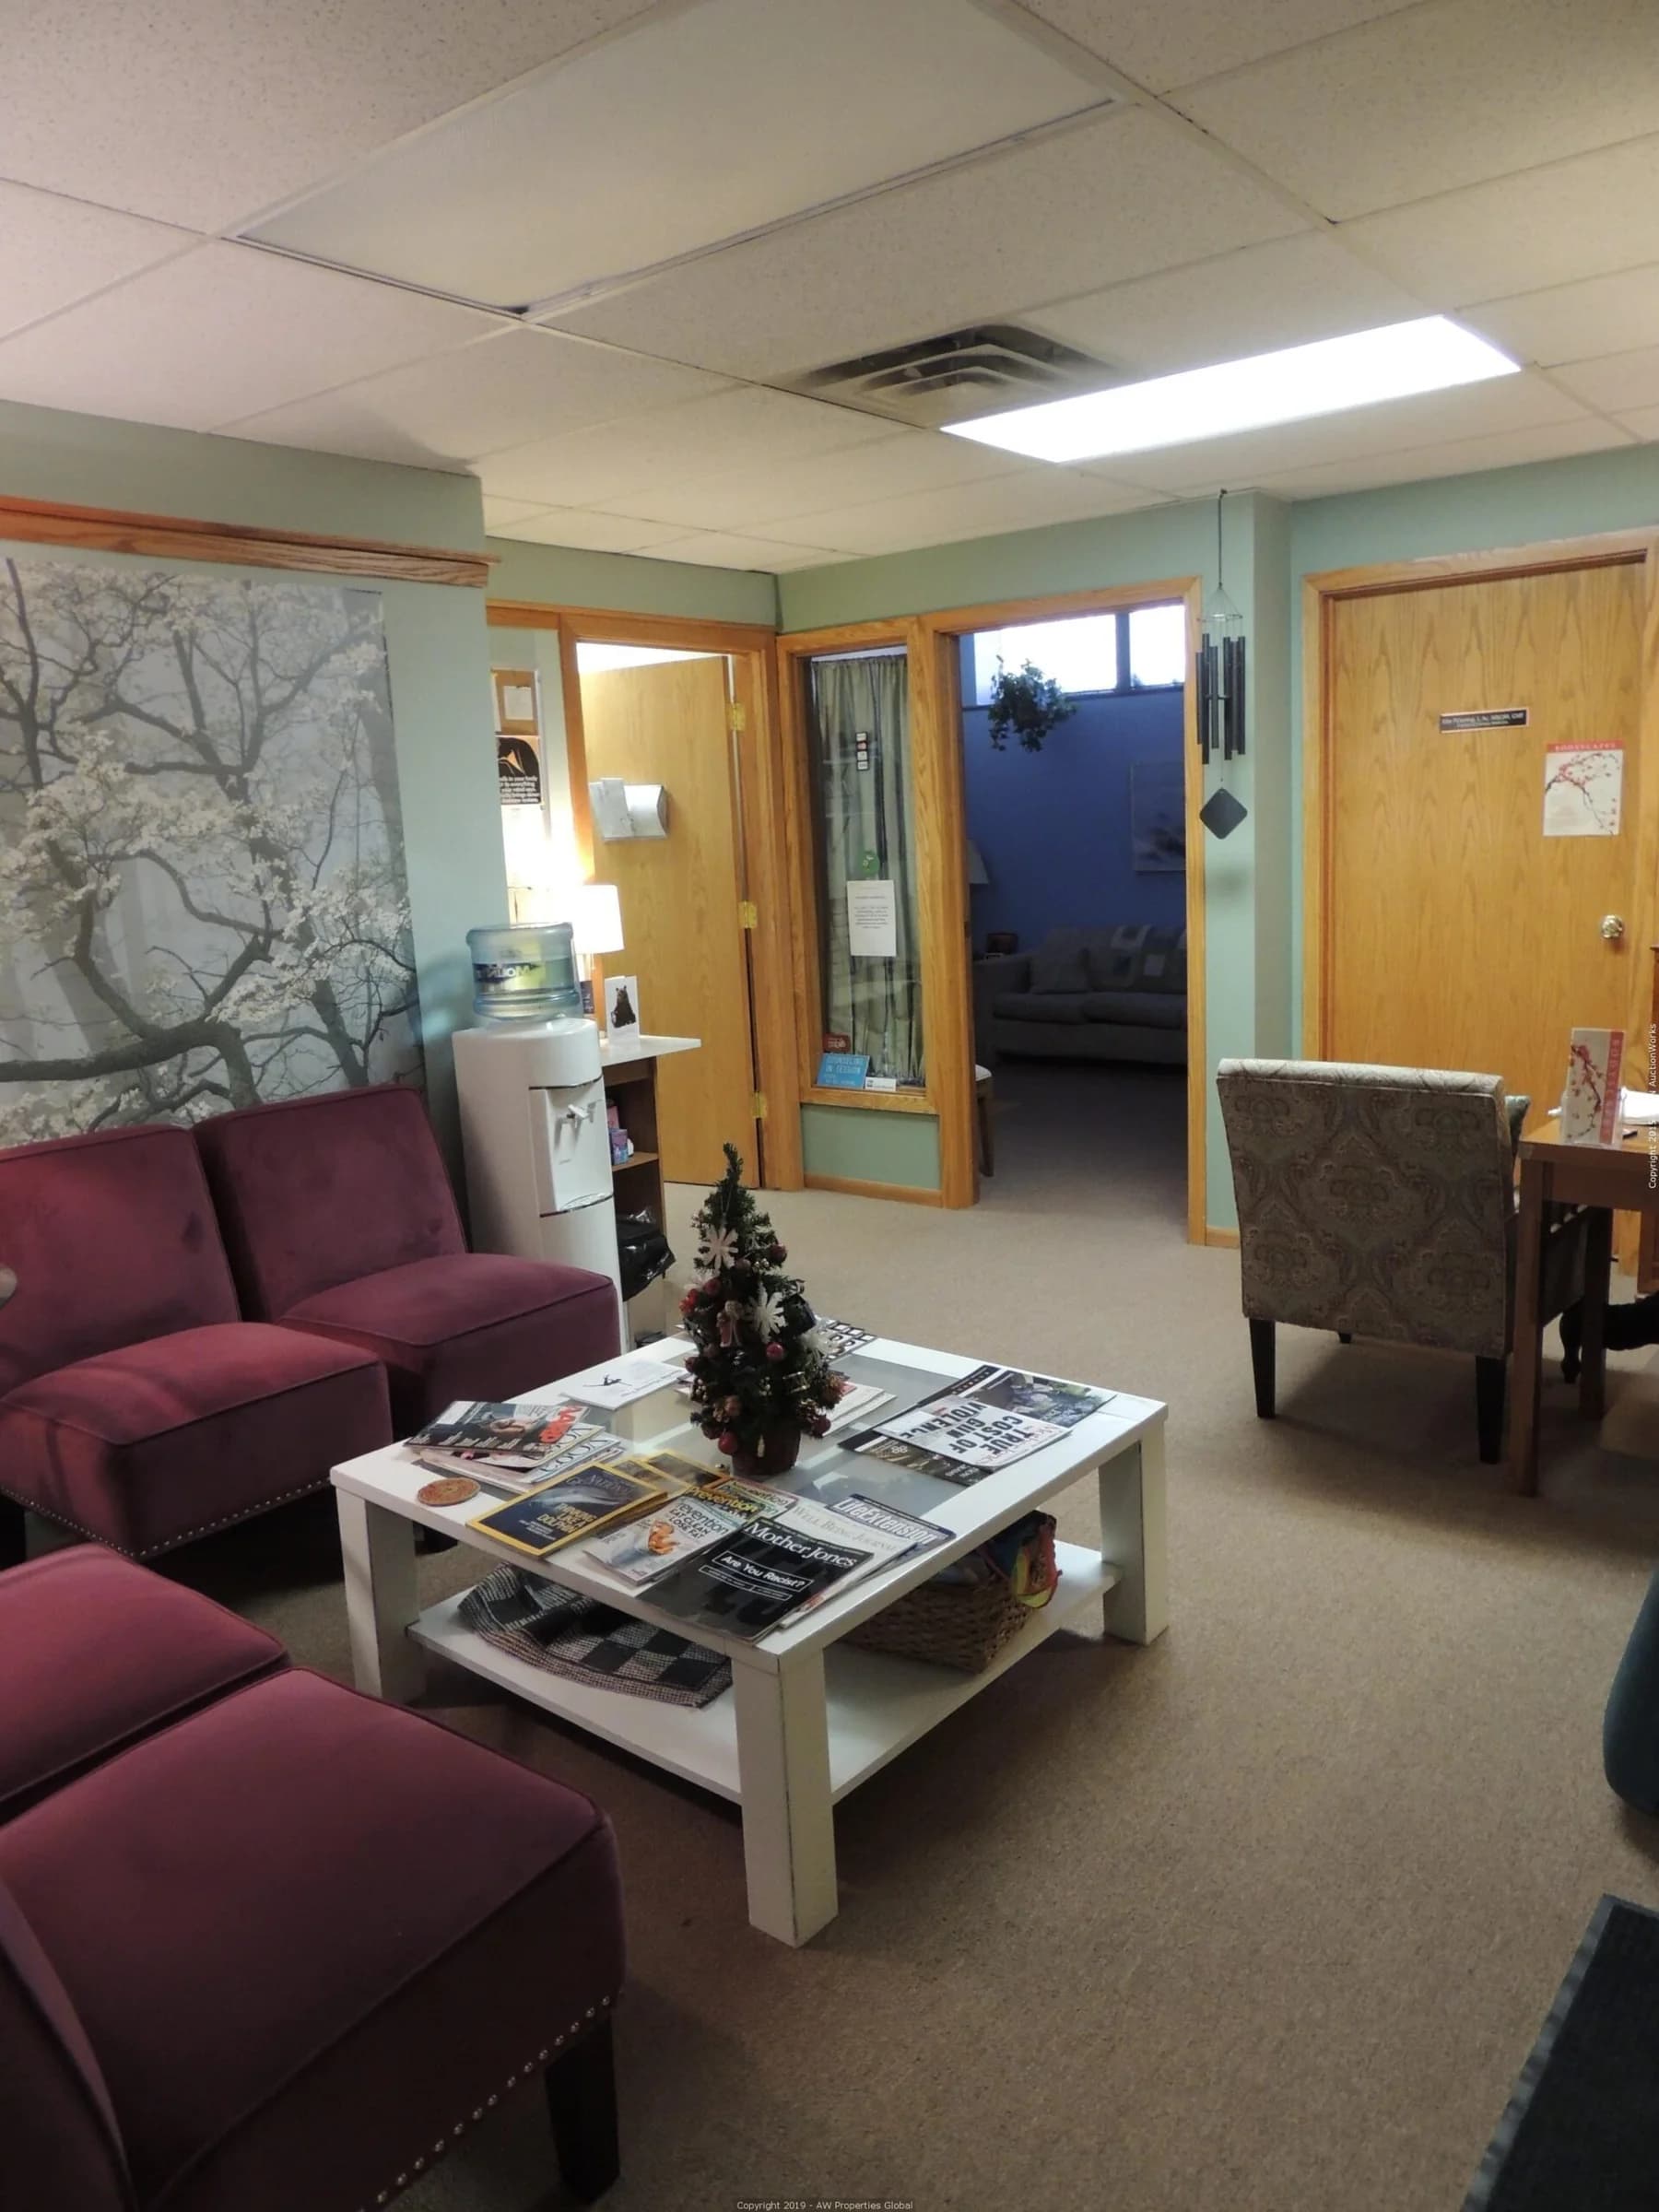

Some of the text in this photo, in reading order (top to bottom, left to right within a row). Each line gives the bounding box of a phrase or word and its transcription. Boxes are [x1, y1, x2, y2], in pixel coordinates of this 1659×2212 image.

[946, 1419, 986, 1439] GUN
[973, 1416, 1024, 1441] COST
[948, 1439, 978, 1453] OF
[981, 1430, 1036, 1454] TRUE
[677, 1501, 729, 1535] revention
[744, 1522, 812, 1555] Mother
[802, 1547, 858, 1567] Jones
[721, 1553, 741, 1568] Are
[743, 1561, 763, 1578] You
[763, 1571, 806, 1589] Racist?
